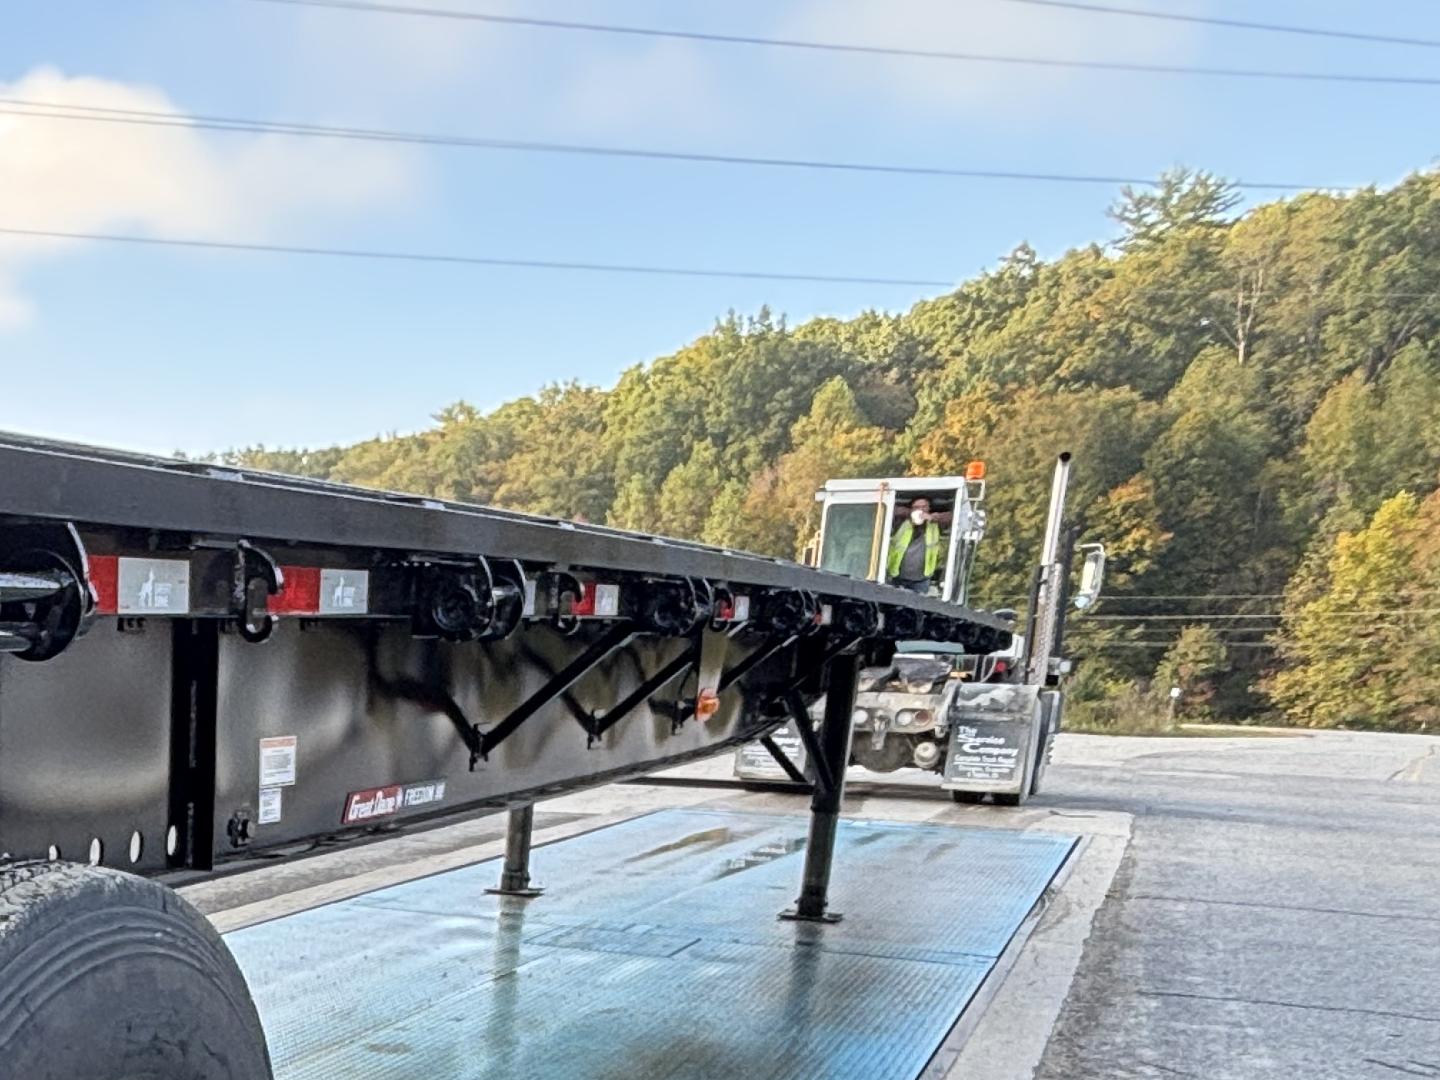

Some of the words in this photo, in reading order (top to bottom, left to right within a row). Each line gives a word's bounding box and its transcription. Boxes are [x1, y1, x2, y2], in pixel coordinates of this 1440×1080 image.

[962, 742, 1019, 757] Company
[348, 794, 375, 821] Great
[371, 790, 396, 816] Dane
